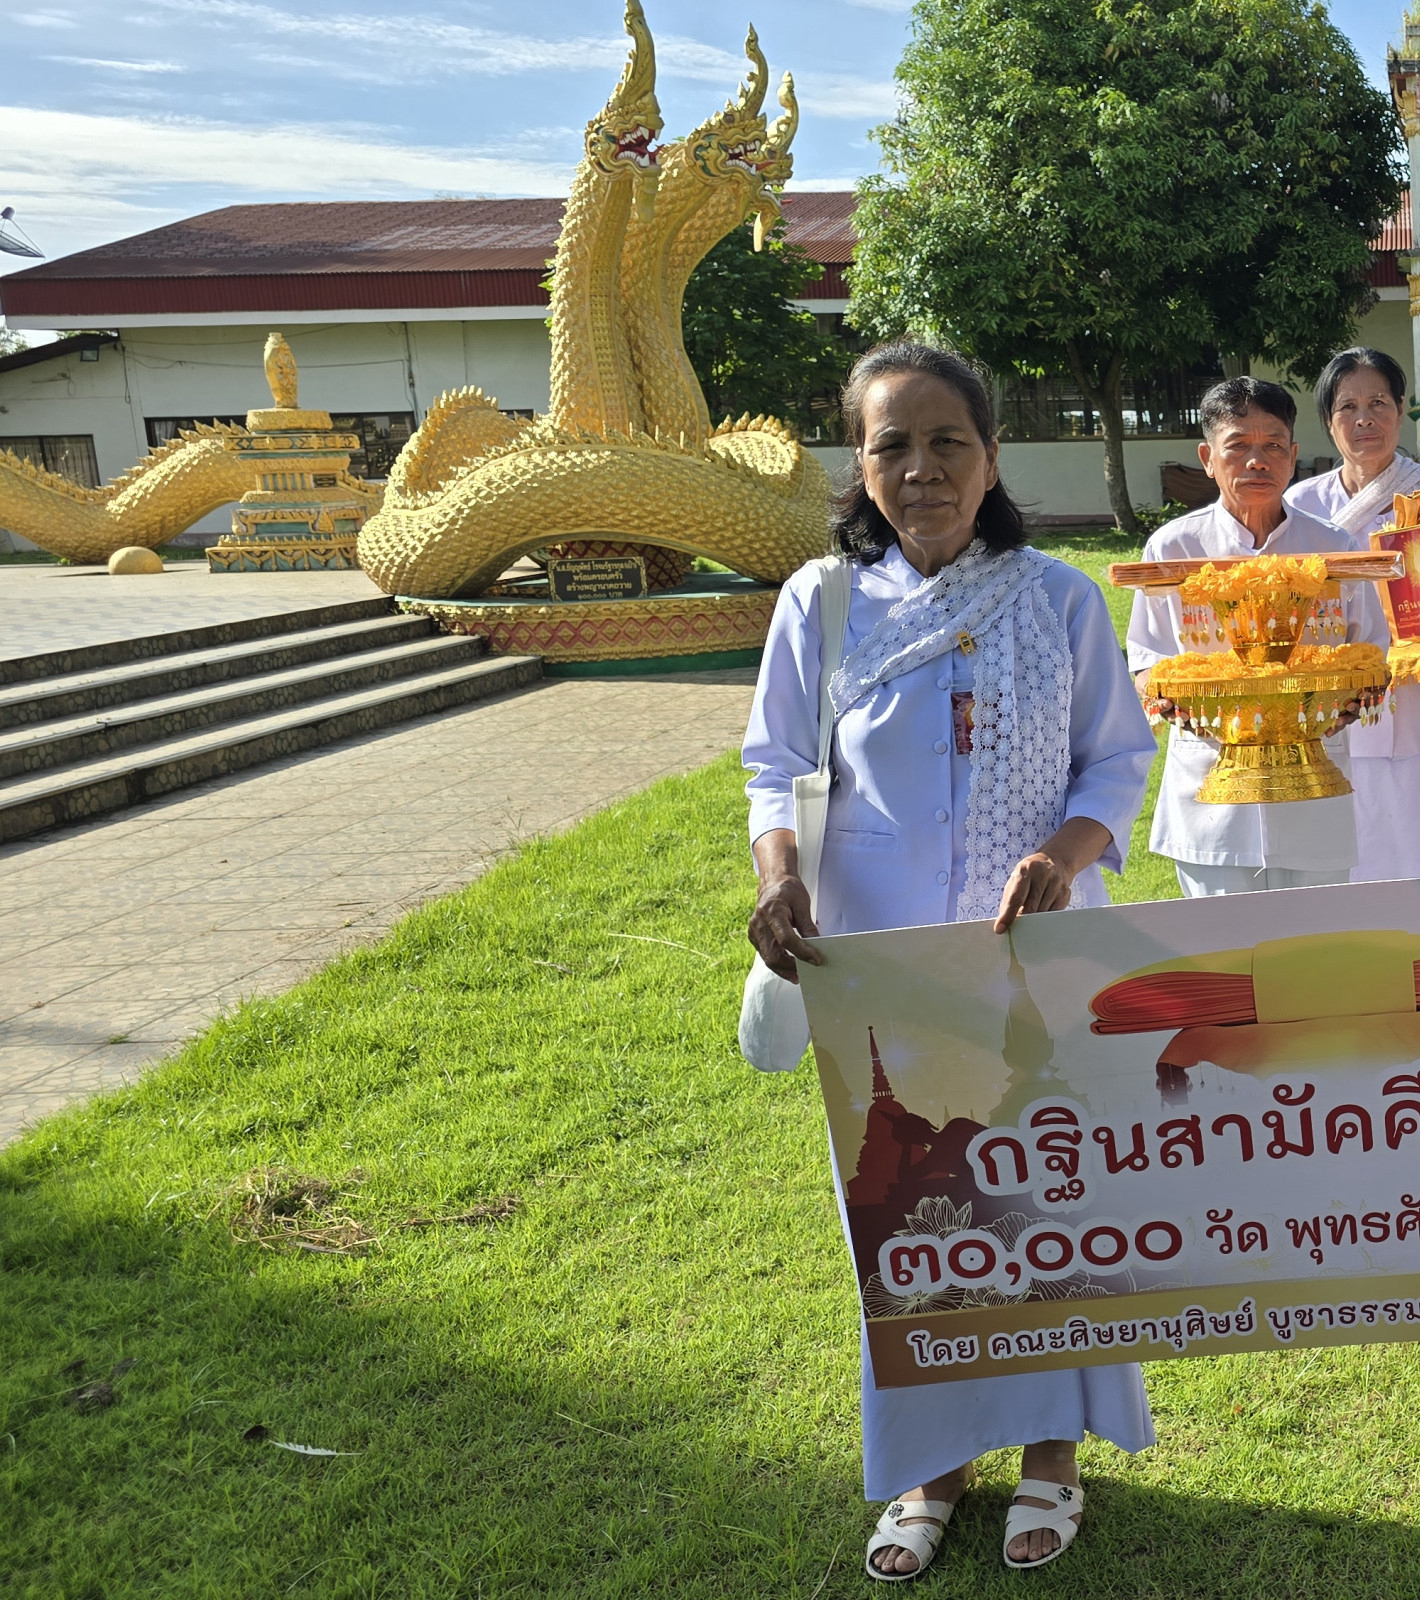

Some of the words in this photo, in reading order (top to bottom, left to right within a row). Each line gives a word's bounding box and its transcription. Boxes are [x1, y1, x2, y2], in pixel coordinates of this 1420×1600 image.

[888, 1219, 1184, 1288] ๓๐,๐๐๐
[1204, 1208, 1270, 1256] วัด
[910, 1333, 977, 1365] โดย
[990, 1300, 1255, 1358] คณะศิษยานุศิษย์
